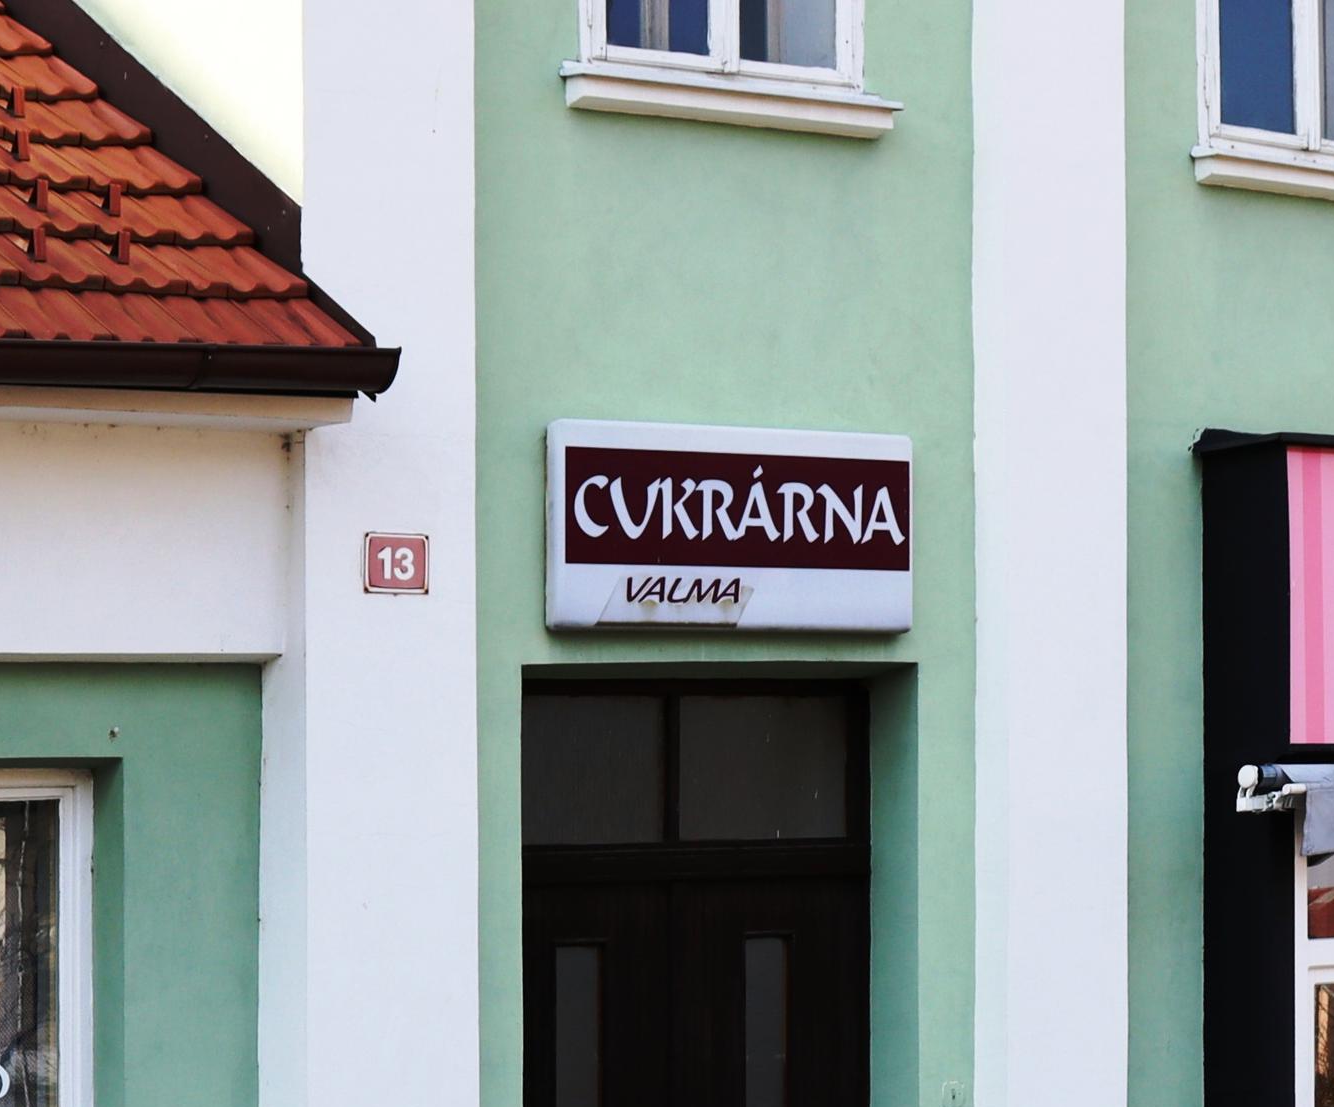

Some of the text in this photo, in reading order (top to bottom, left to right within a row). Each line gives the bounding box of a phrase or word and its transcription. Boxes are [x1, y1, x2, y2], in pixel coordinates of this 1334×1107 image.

[573, 464, 906, 547] CUKRÁRNA
[377, 546, 415, 582] 13
[625, 576, 742, 605] VALMA
